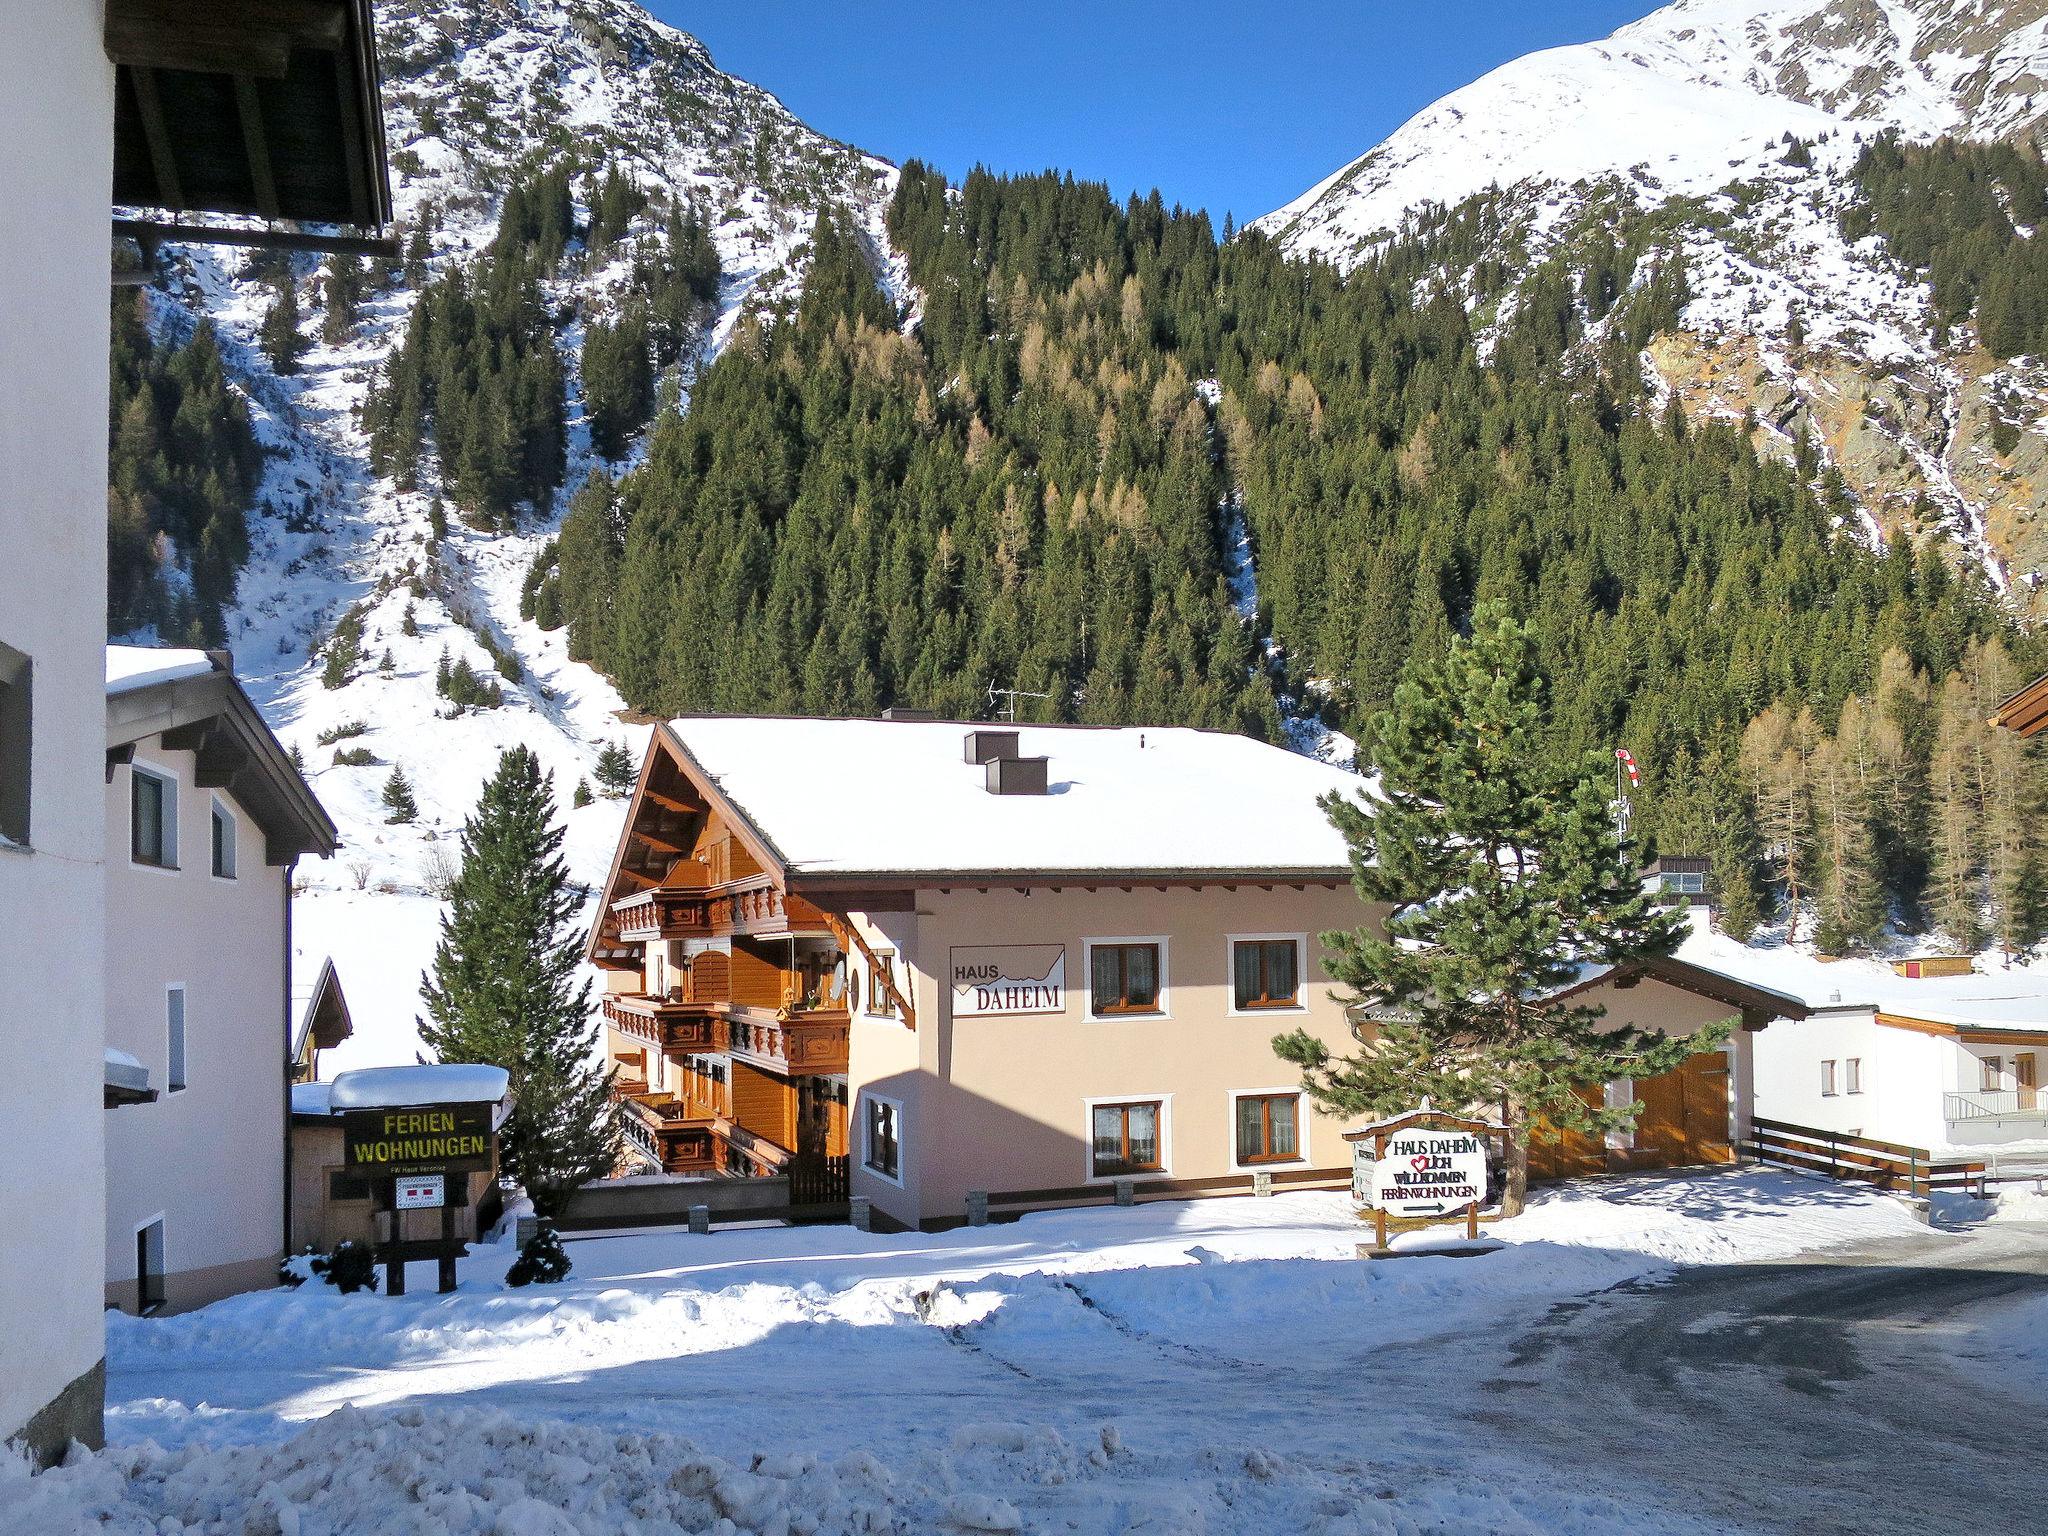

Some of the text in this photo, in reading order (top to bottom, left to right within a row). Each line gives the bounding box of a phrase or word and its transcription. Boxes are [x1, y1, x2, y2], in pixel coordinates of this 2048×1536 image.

[955, 965, 998, 979] HAUS
[976, 985, 1060, 1010] DAHEIM
[384, 1113, 455, 1135] FERIEN
[354, 1135, 484, 1163] WOHNUNGEN
[1394, 1140, 1427, 1155] HAUS
[1394, 1171, 1467, 1185] WILLKOMMEN
[1382, 1186, 1477, 1200] FERIENWOHNUNGEN
